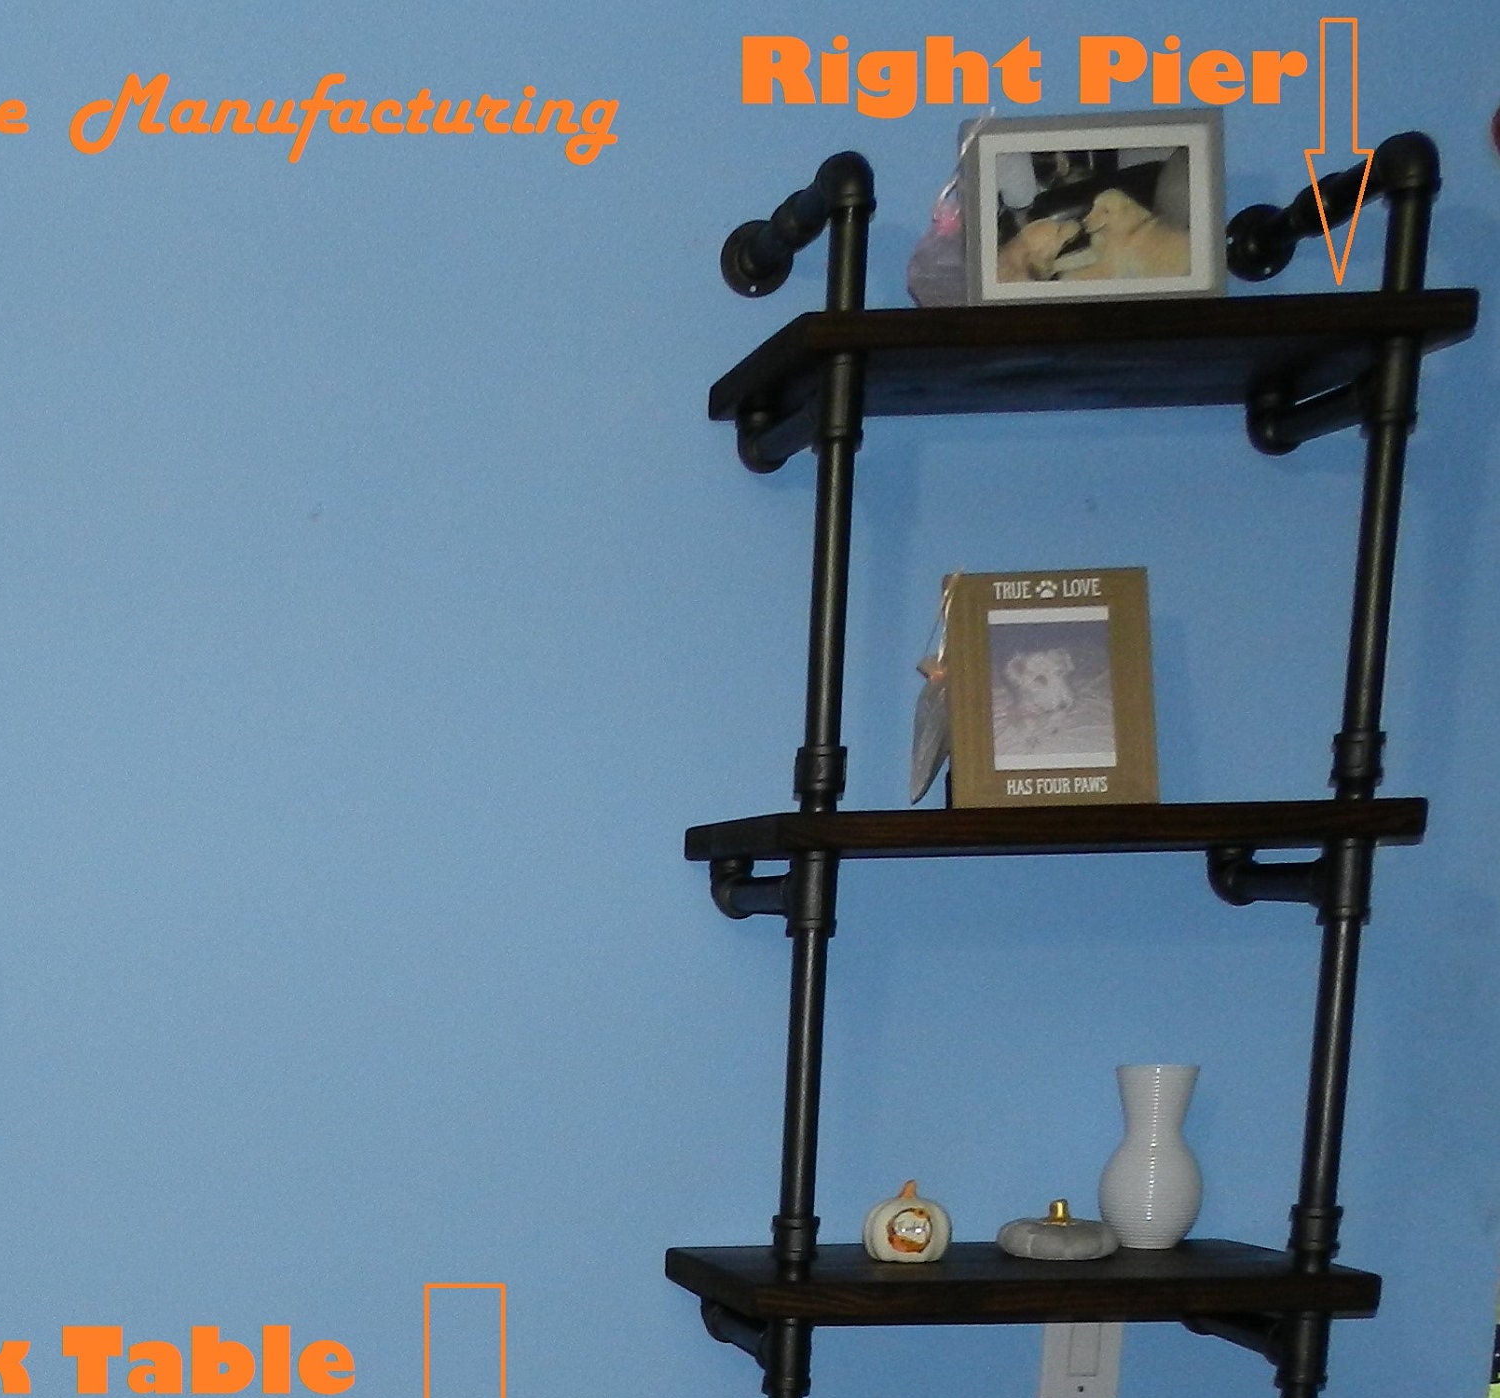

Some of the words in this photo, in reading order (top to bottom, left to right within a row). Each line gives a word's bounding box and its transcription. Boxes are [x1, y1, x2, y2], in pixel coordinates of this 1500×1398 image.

[993, 580, 1032, 600] TRUE
[1062, 577, 1102, 598] LOVE
[1006, 778, 1033, 796] HAS
[1036, 777, 1071, 795] FOUR
[1074, 775, 1109, 794] PAWS
